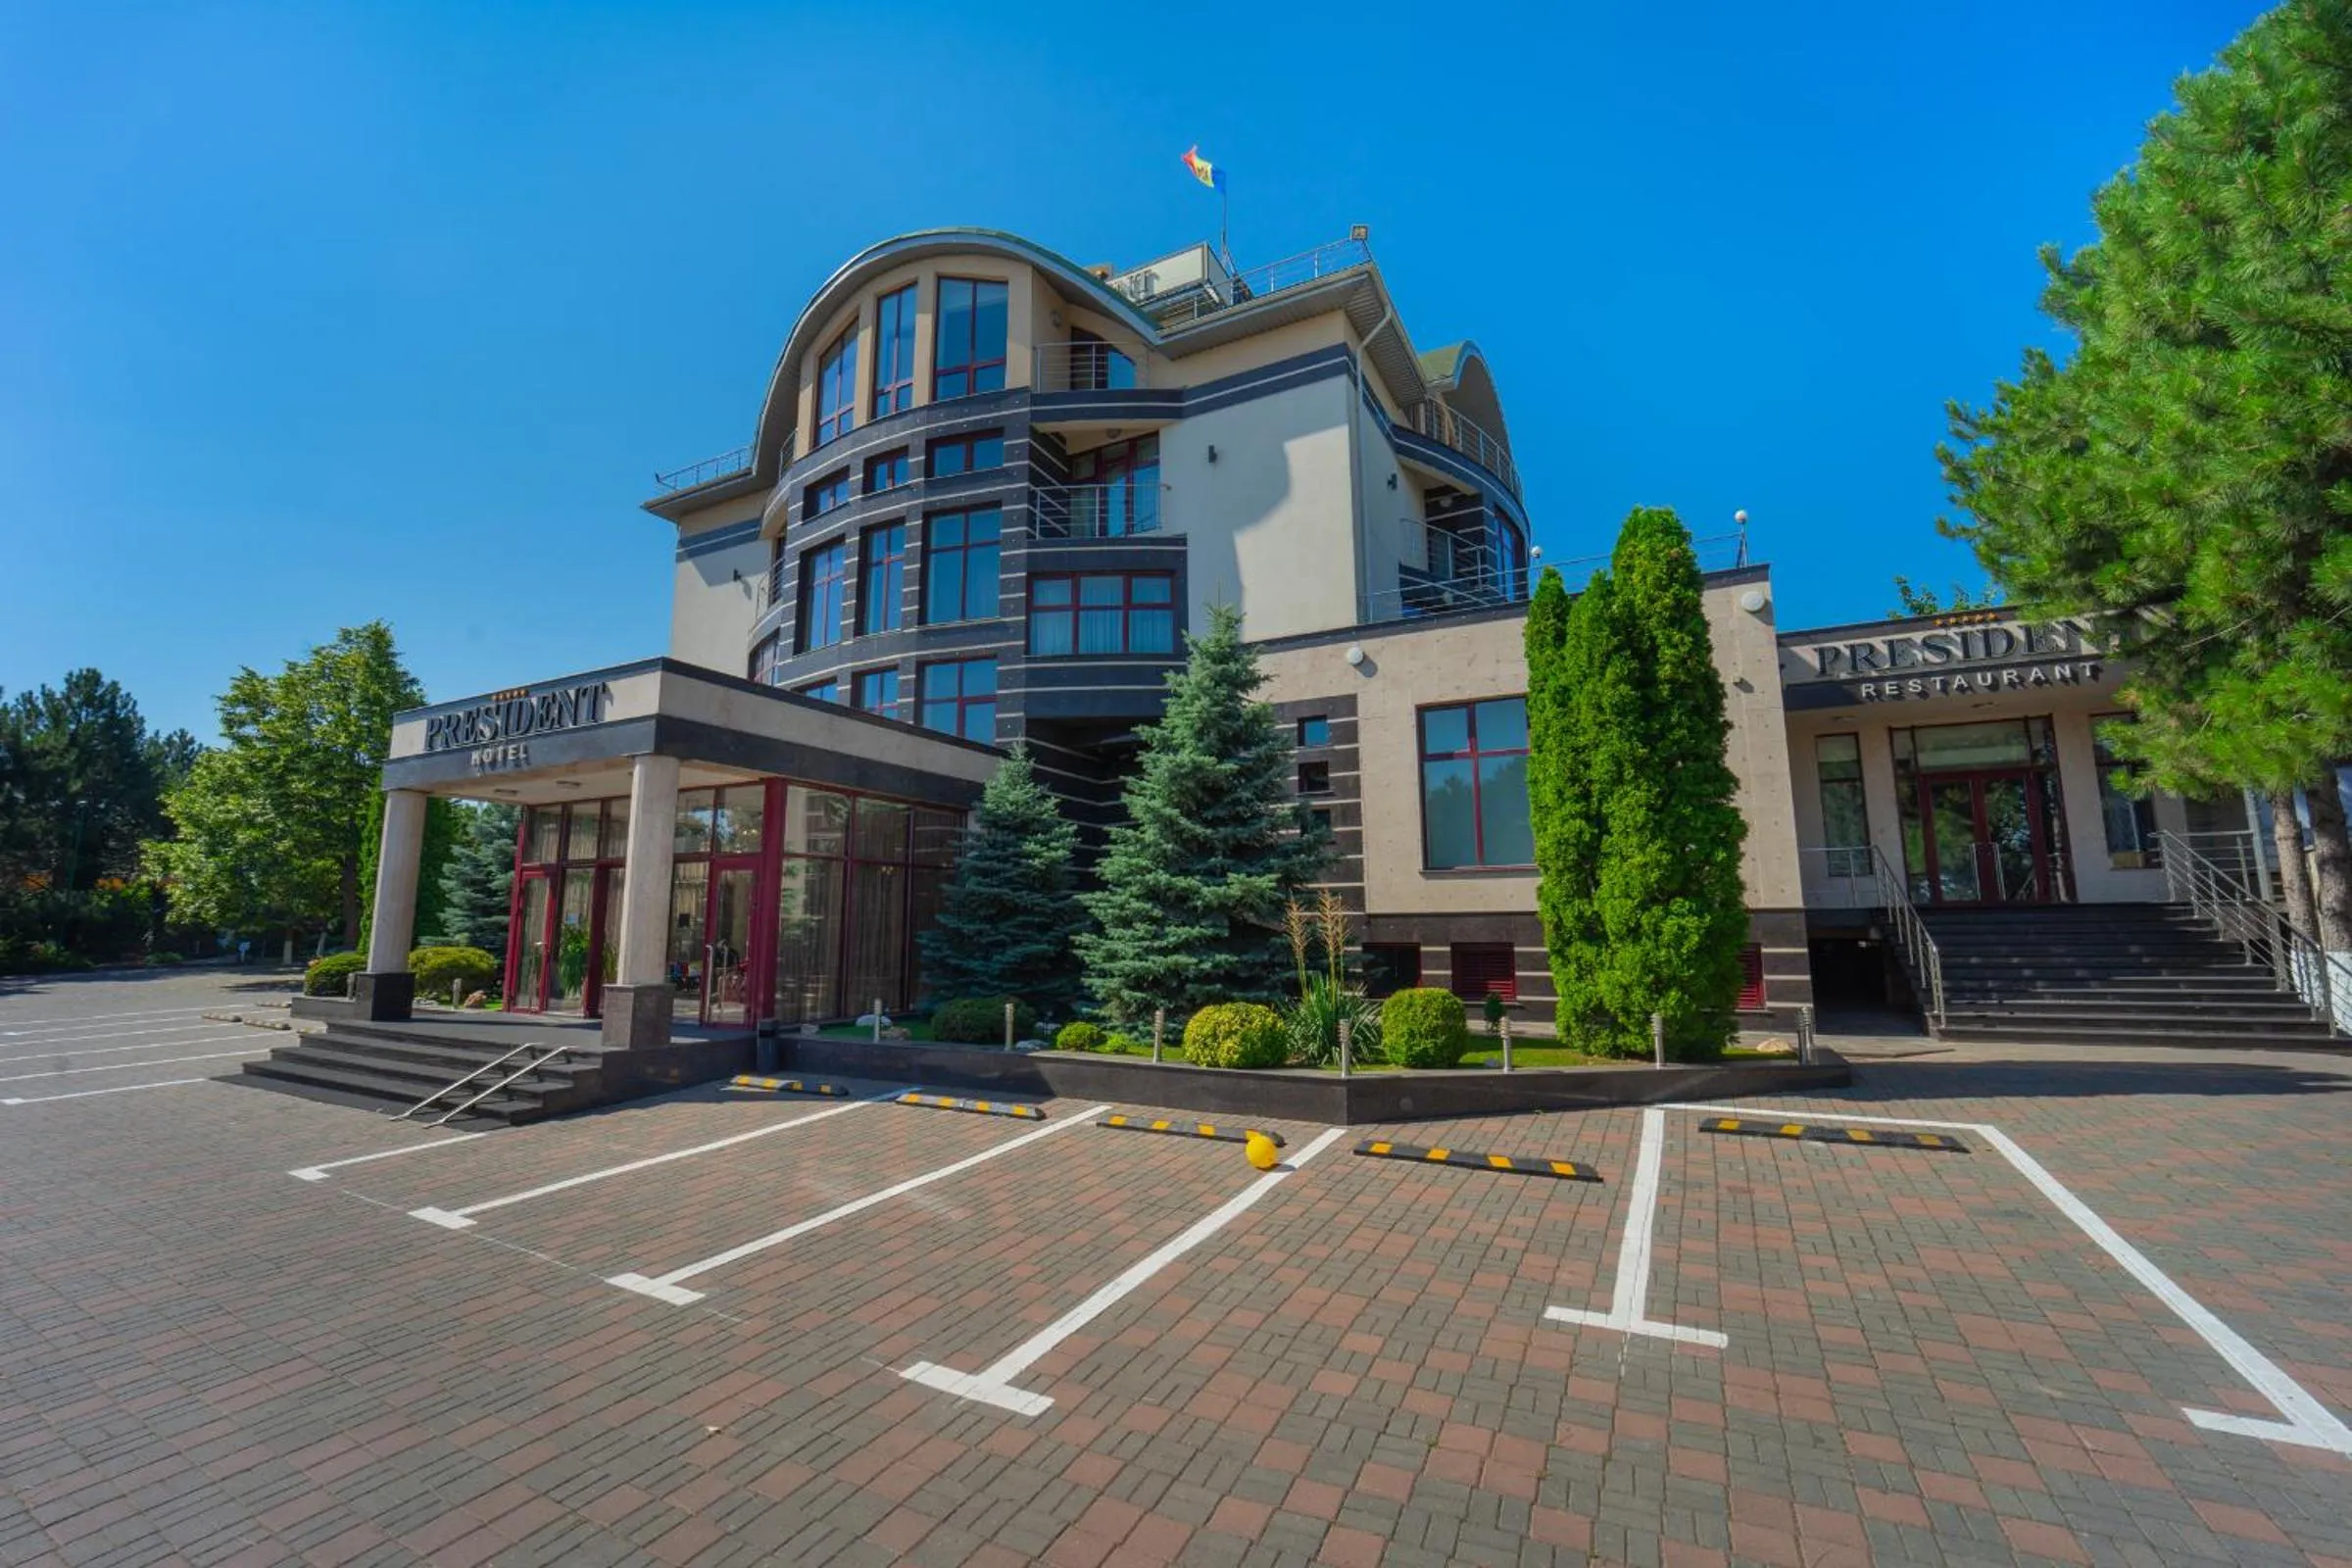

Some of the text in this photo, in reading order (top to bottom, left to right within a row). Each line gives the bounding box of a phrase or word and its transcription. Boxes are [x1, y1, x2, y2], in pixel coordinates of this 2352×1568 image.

[1812, 616, 2122, 678] PRESIDEN
[1861, 662, 2095, 698] RESTAURANT
[425, 683, 610, 751] PRESIDENT
[470, 744, 528, 765] HOTEL
